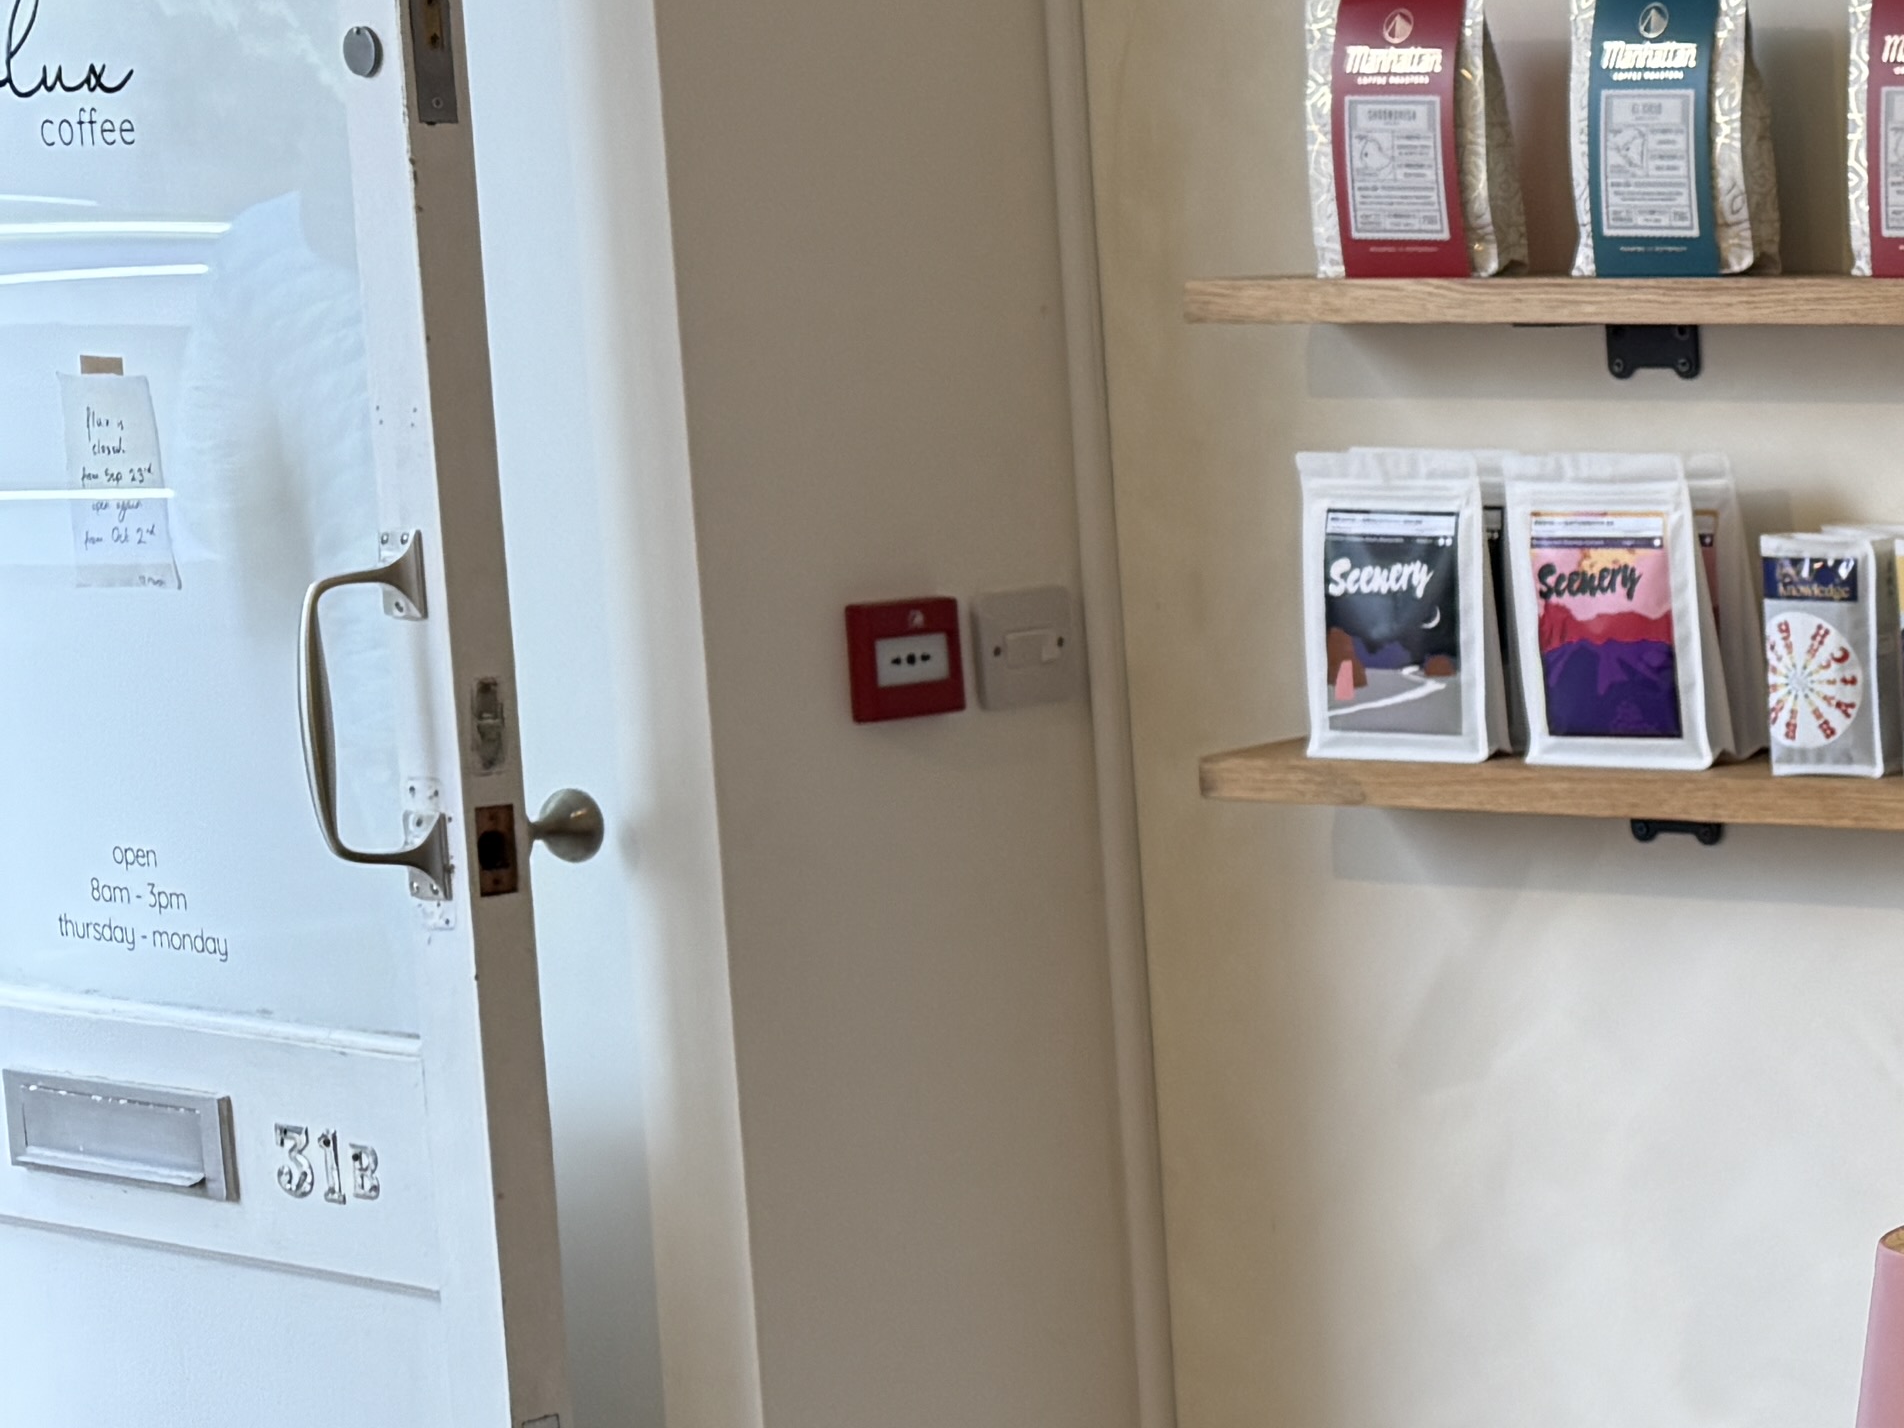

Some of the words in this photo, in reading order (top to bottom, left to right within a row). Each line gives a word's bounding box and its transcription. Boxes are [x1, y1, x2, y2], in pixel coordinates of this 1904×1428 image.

[1345, 46, 1442, 73] Manhattan
[1602, 40, 1697, 70] Manhattan
[41, 107, 135, 146] coffee
[1328, 557, 1434, 600] Scenery
[1537, 562, 1642, 602] Scenery
[112, 845, 158, 871] open
[91, 877, 131, 905] 8am
[147, 882, 188, 914] 3pm
[58, 913, 136, 951] thursday
[152, 928, 229, 963] monday
